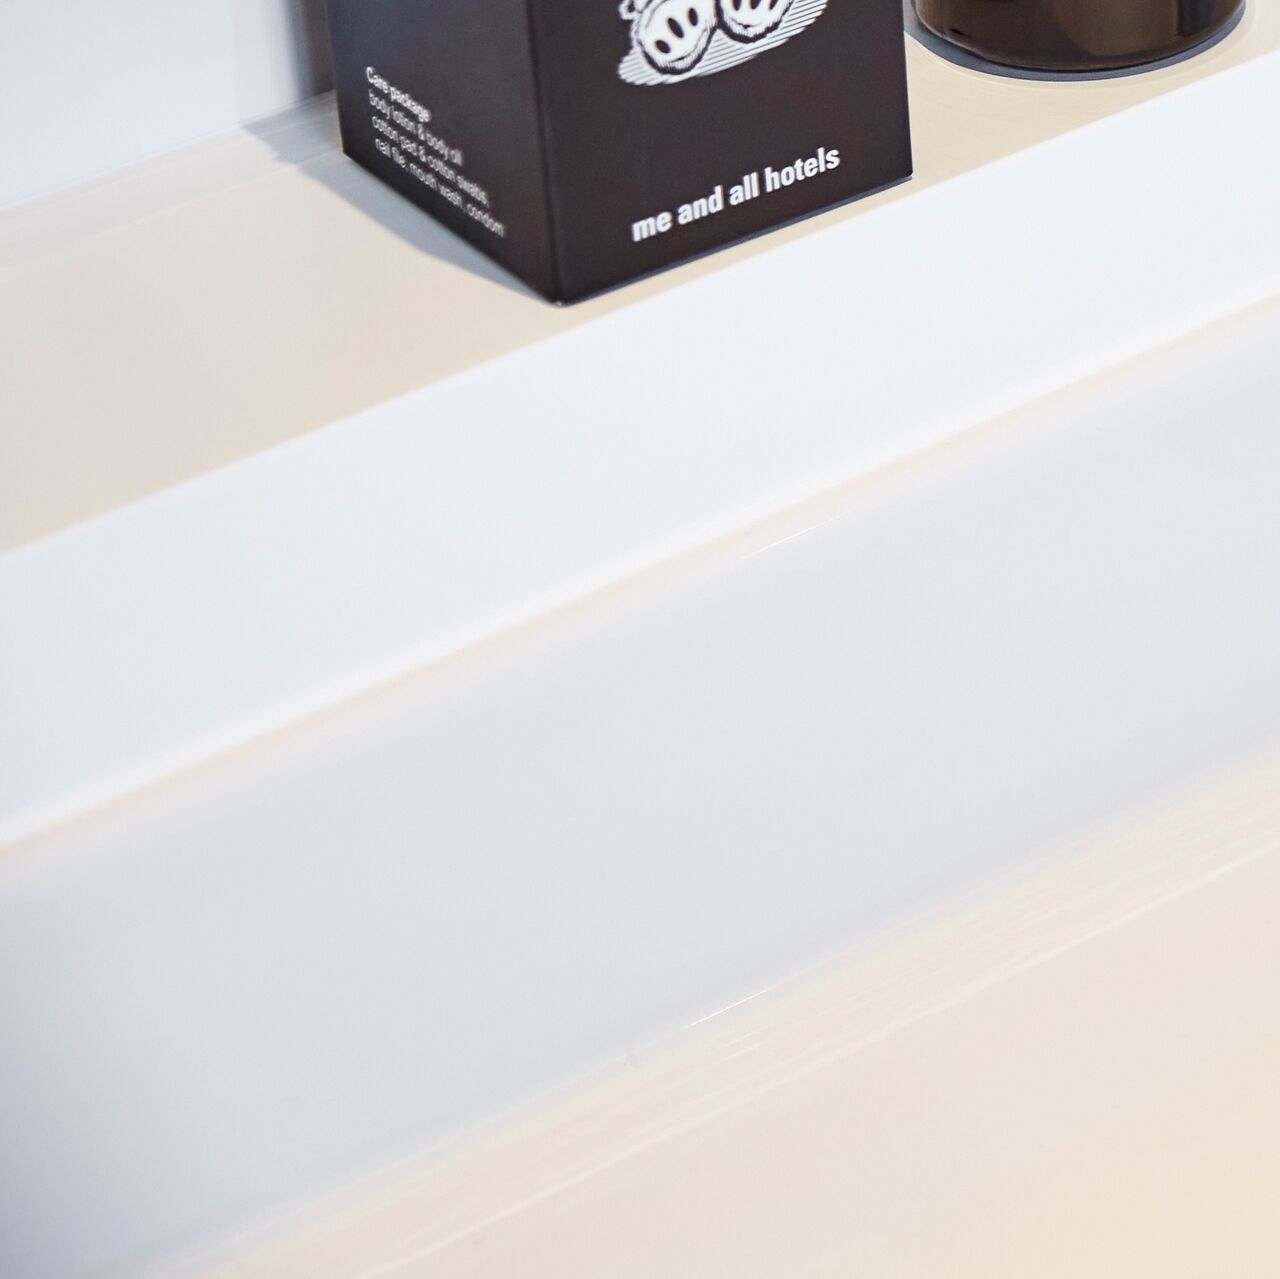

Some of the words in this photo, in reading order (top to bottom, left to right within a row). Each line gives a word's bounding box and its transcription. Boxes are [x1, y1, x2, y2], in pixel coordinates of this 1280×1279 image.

[366, 67, 388, 93] Care
[389, 85, 432, 122] package
[369, 89, 390, 119] body
[418, 123, 426, 141] &
[427, 130, 449, 160] body
[372, 116, 399, 143] cotton
[418, 145, 427, 163] &
[428, 154, 456, 183] cotton
[375, 138, 392, 158] nail
[409, 162, 438, 191] mouth
[466, 203, 505, 237] condom
[632, 211, 672, 242] me
[677, 185, 724, 225] and
[728, 172, 760, 207] all
[764, 146, 841, 193] hotels
